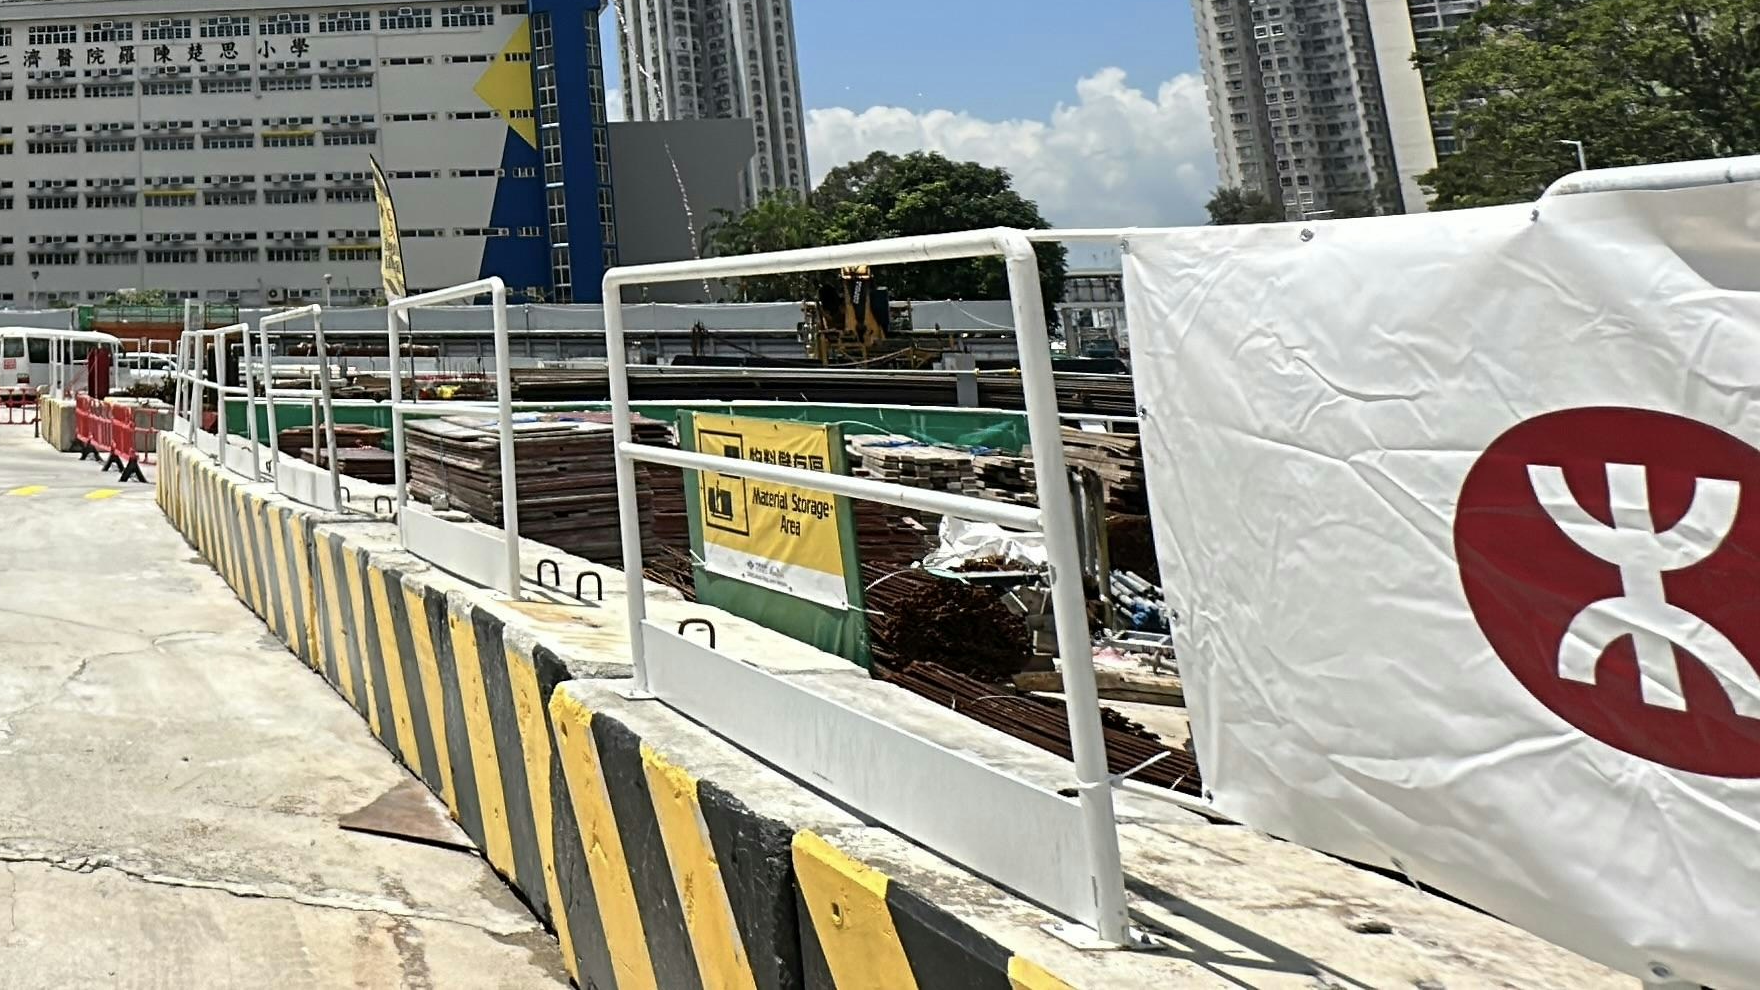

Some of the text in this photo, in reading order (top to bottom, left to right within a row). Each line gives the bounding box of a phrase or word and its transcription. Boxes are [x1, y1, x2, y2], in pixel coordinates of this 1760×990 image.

[752, 487, 829, 520] Material Storage
[780, 514, 801, 537] Area
